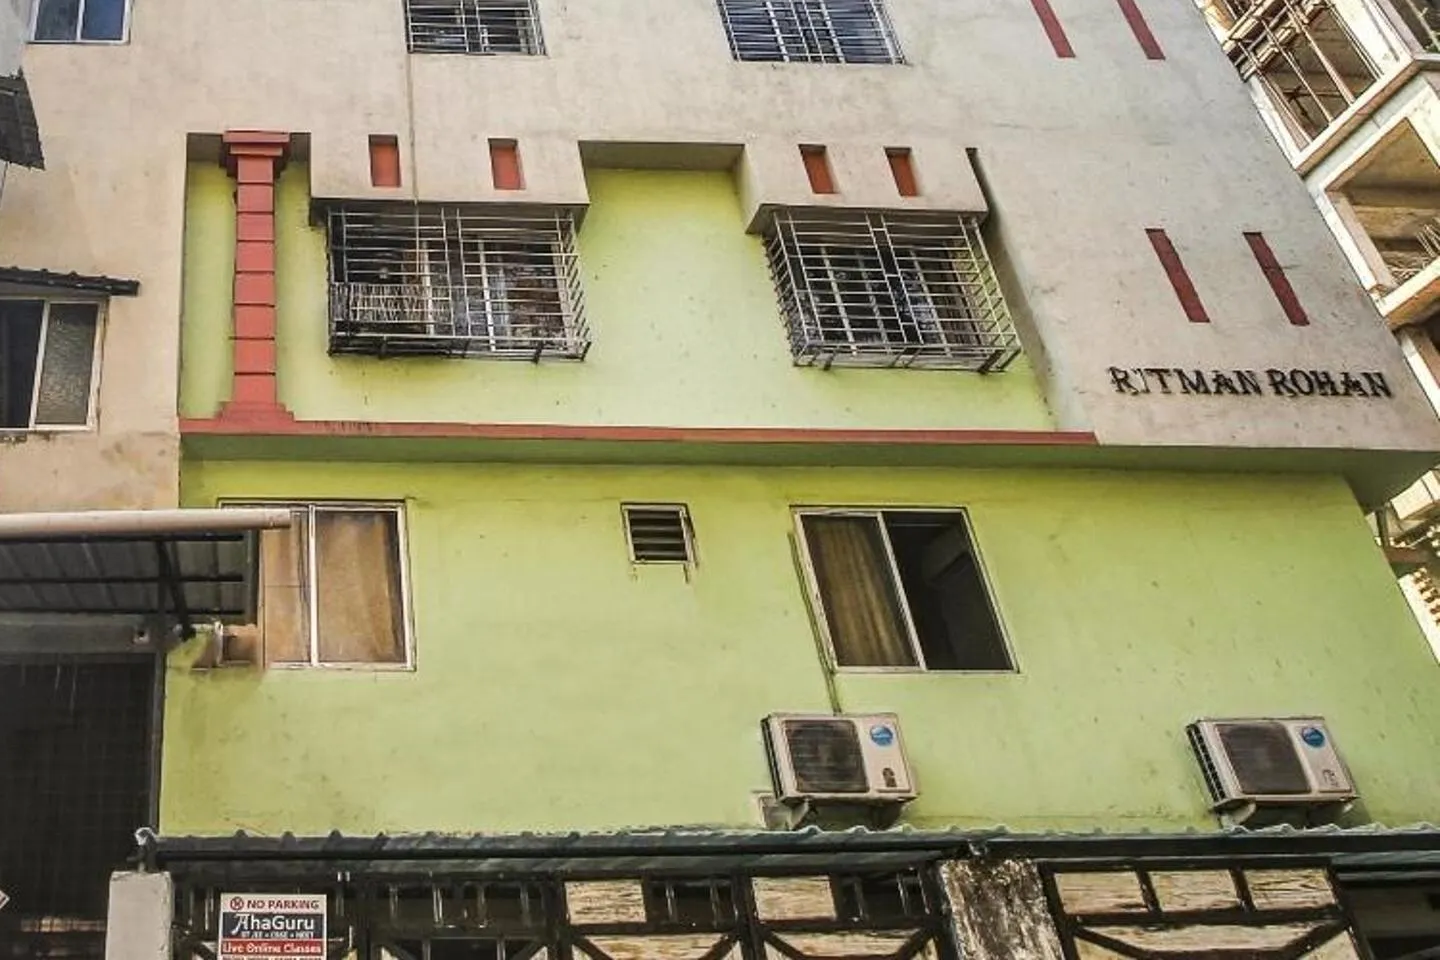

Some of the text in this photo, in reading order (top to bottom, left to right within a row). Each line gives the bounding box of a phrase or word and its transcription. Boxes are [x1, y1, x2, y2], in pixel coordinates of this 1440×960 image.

[1265, 368, 1392, 398] ROHAN
[247, 900, 320, 909] NO PARKING
[231, 913, 314, 935] AhaGuru
[223, 942, 321, 953] Live Online Classes
